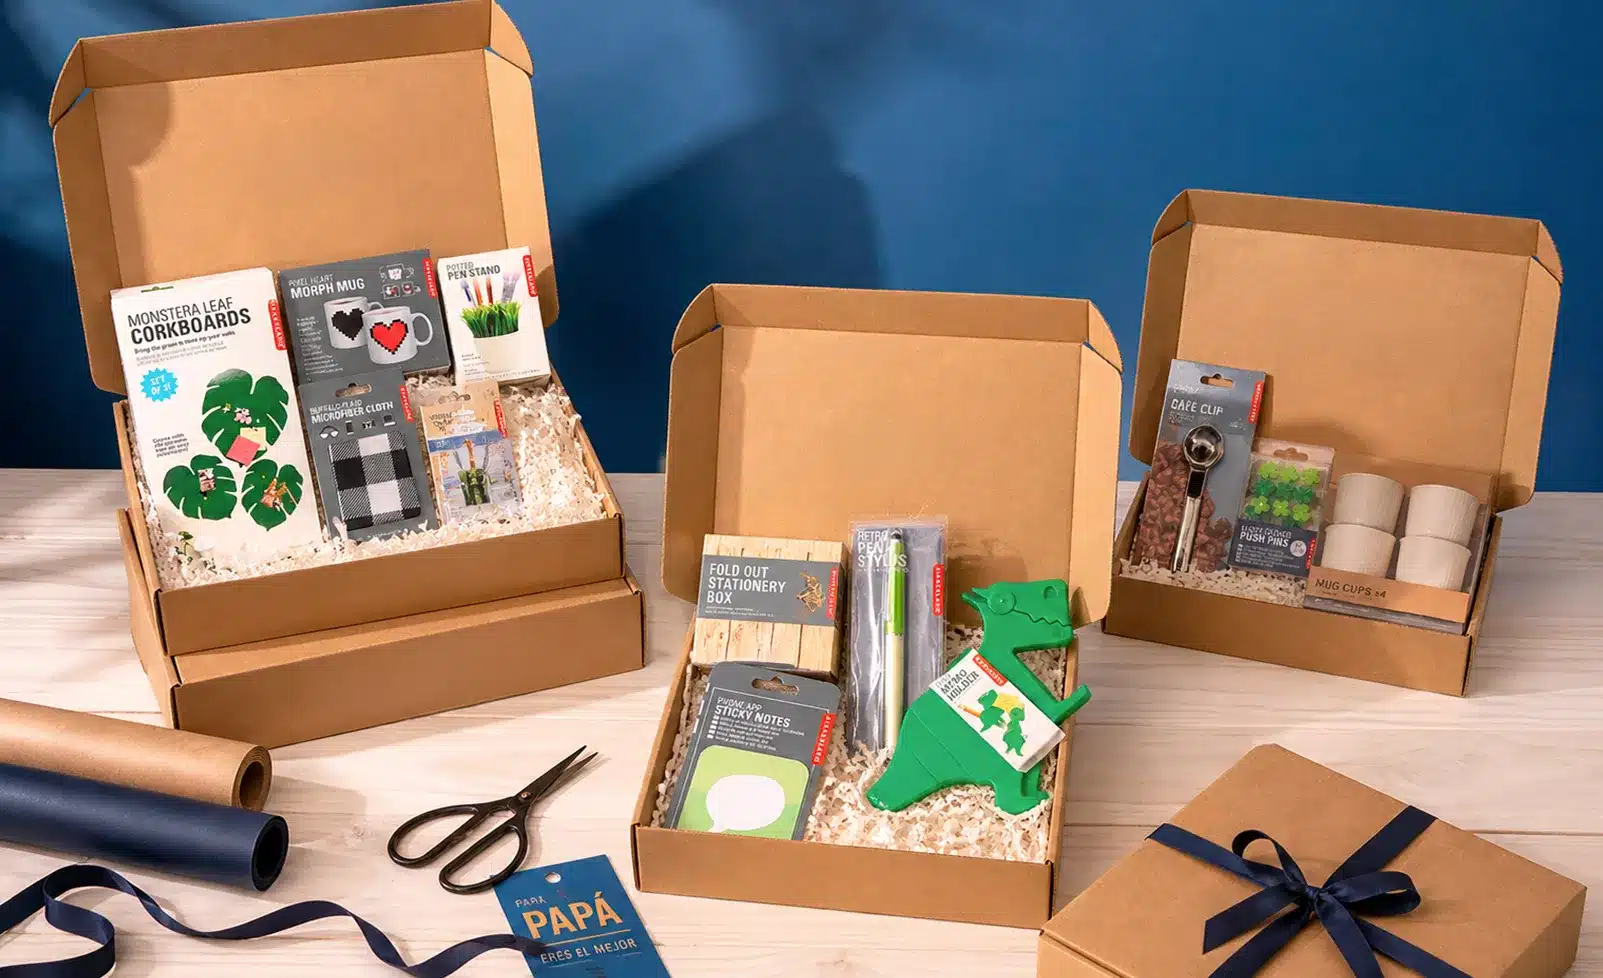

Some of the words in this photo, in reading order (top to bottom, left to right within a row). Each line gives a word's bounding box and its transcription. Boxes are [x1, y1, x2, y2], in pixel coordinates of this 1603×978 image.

[447, 269, 468, 281] PEN
[469, 264, 501, 278] STAND
[290, 282, 335, 299] MORPH
[336, 278, 366, 292] MUG
[127, 303, 201, 328] MONSTERA
[202, 297, 233, 312] LEAF
[131, 308, 251, 345] CORKBOARDS
[365, 401, 394, 414] CLOTH
[1239, 531, 1266, 544] PUSH
[1266, 535, 1290, 548] PINS
[709, 562, 740, 577] FOLD
[743, 565, 769, 579] OUT
[708, 576, 787, 594] STATIONERY
[1315, 578, 1340, 591] MUG
[1342, 583, 1372, 596] CUPS
[706, 591, 733, 604] BOX
[714, 705, 754, 721] STICKY
[754, 712, 792, 728] NOTES
[521, 891, 624, 940] PAPÁ
[540, 949, 573, 964] ERES
[575, 945, 591, 959] EL
[594, 938, 638, 955] MEJOR
